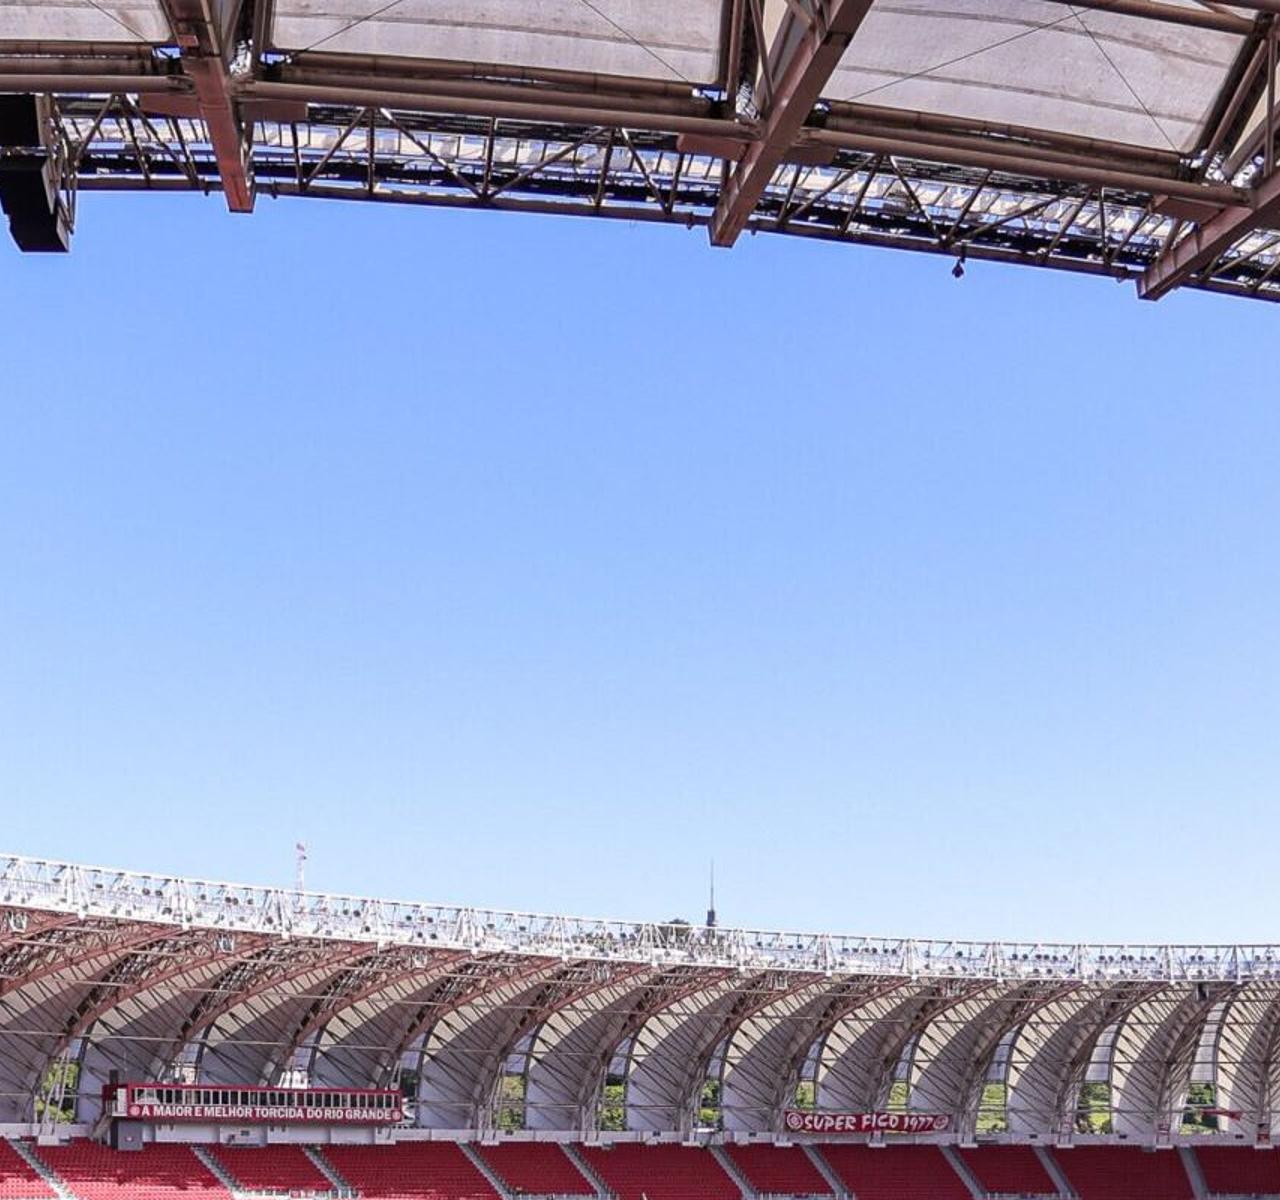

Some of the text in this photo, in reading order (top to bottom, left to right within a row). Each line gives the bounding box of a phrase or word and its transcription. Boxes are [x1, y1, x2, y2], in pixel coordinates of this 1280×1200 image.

[142, 1105, 392, 1121] A MAIOR E MELHOR TORCIDA DO RIO GRANDE
[803, 1114, 857, 1131] SUPER
[904, 1115, 934, 1131] 1977
